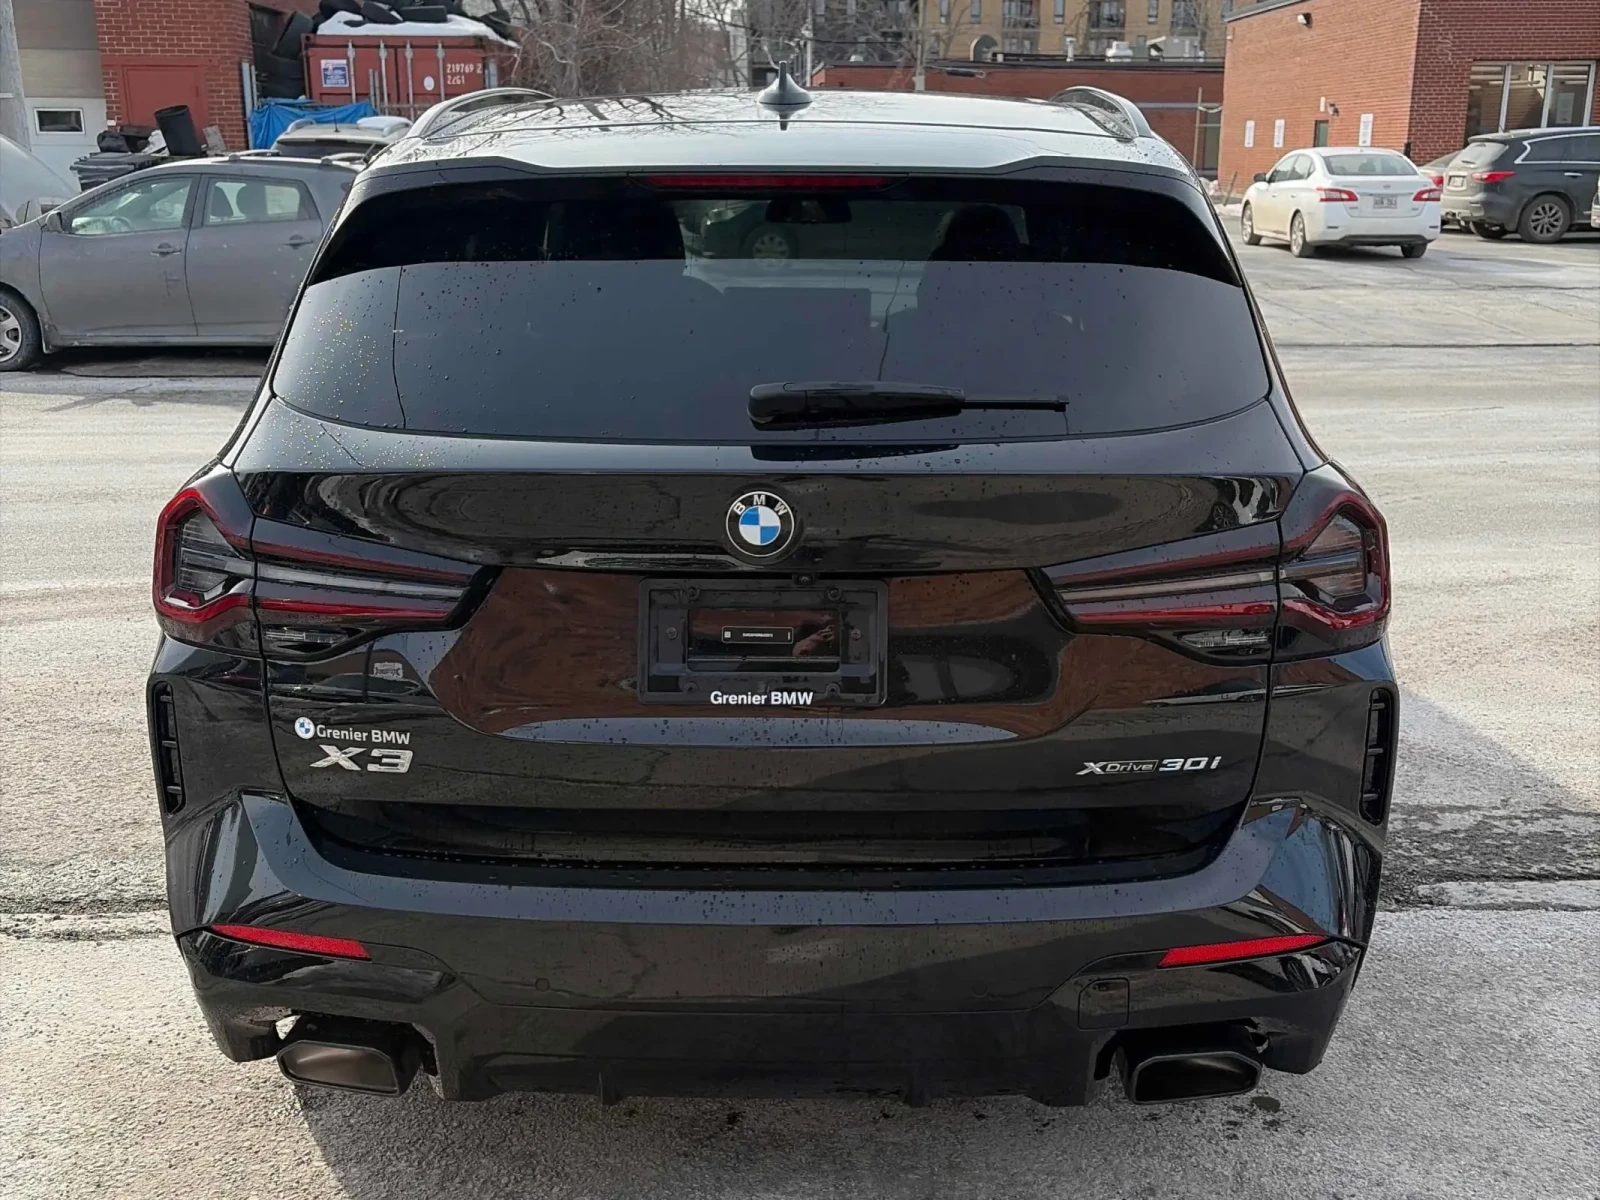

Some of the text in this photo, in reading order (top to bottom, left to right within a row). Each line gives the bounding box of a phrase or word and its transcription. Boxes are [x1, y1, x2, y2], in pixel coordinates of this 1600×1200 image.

[446, 63, 474, 73] 219769
[733, 494, 788, 516] BMW
[710, 690, 814, 705] Grenier BMW
[316, 724, 410, 745] Grenier BMW
[309, 744, 413, 774] X3
